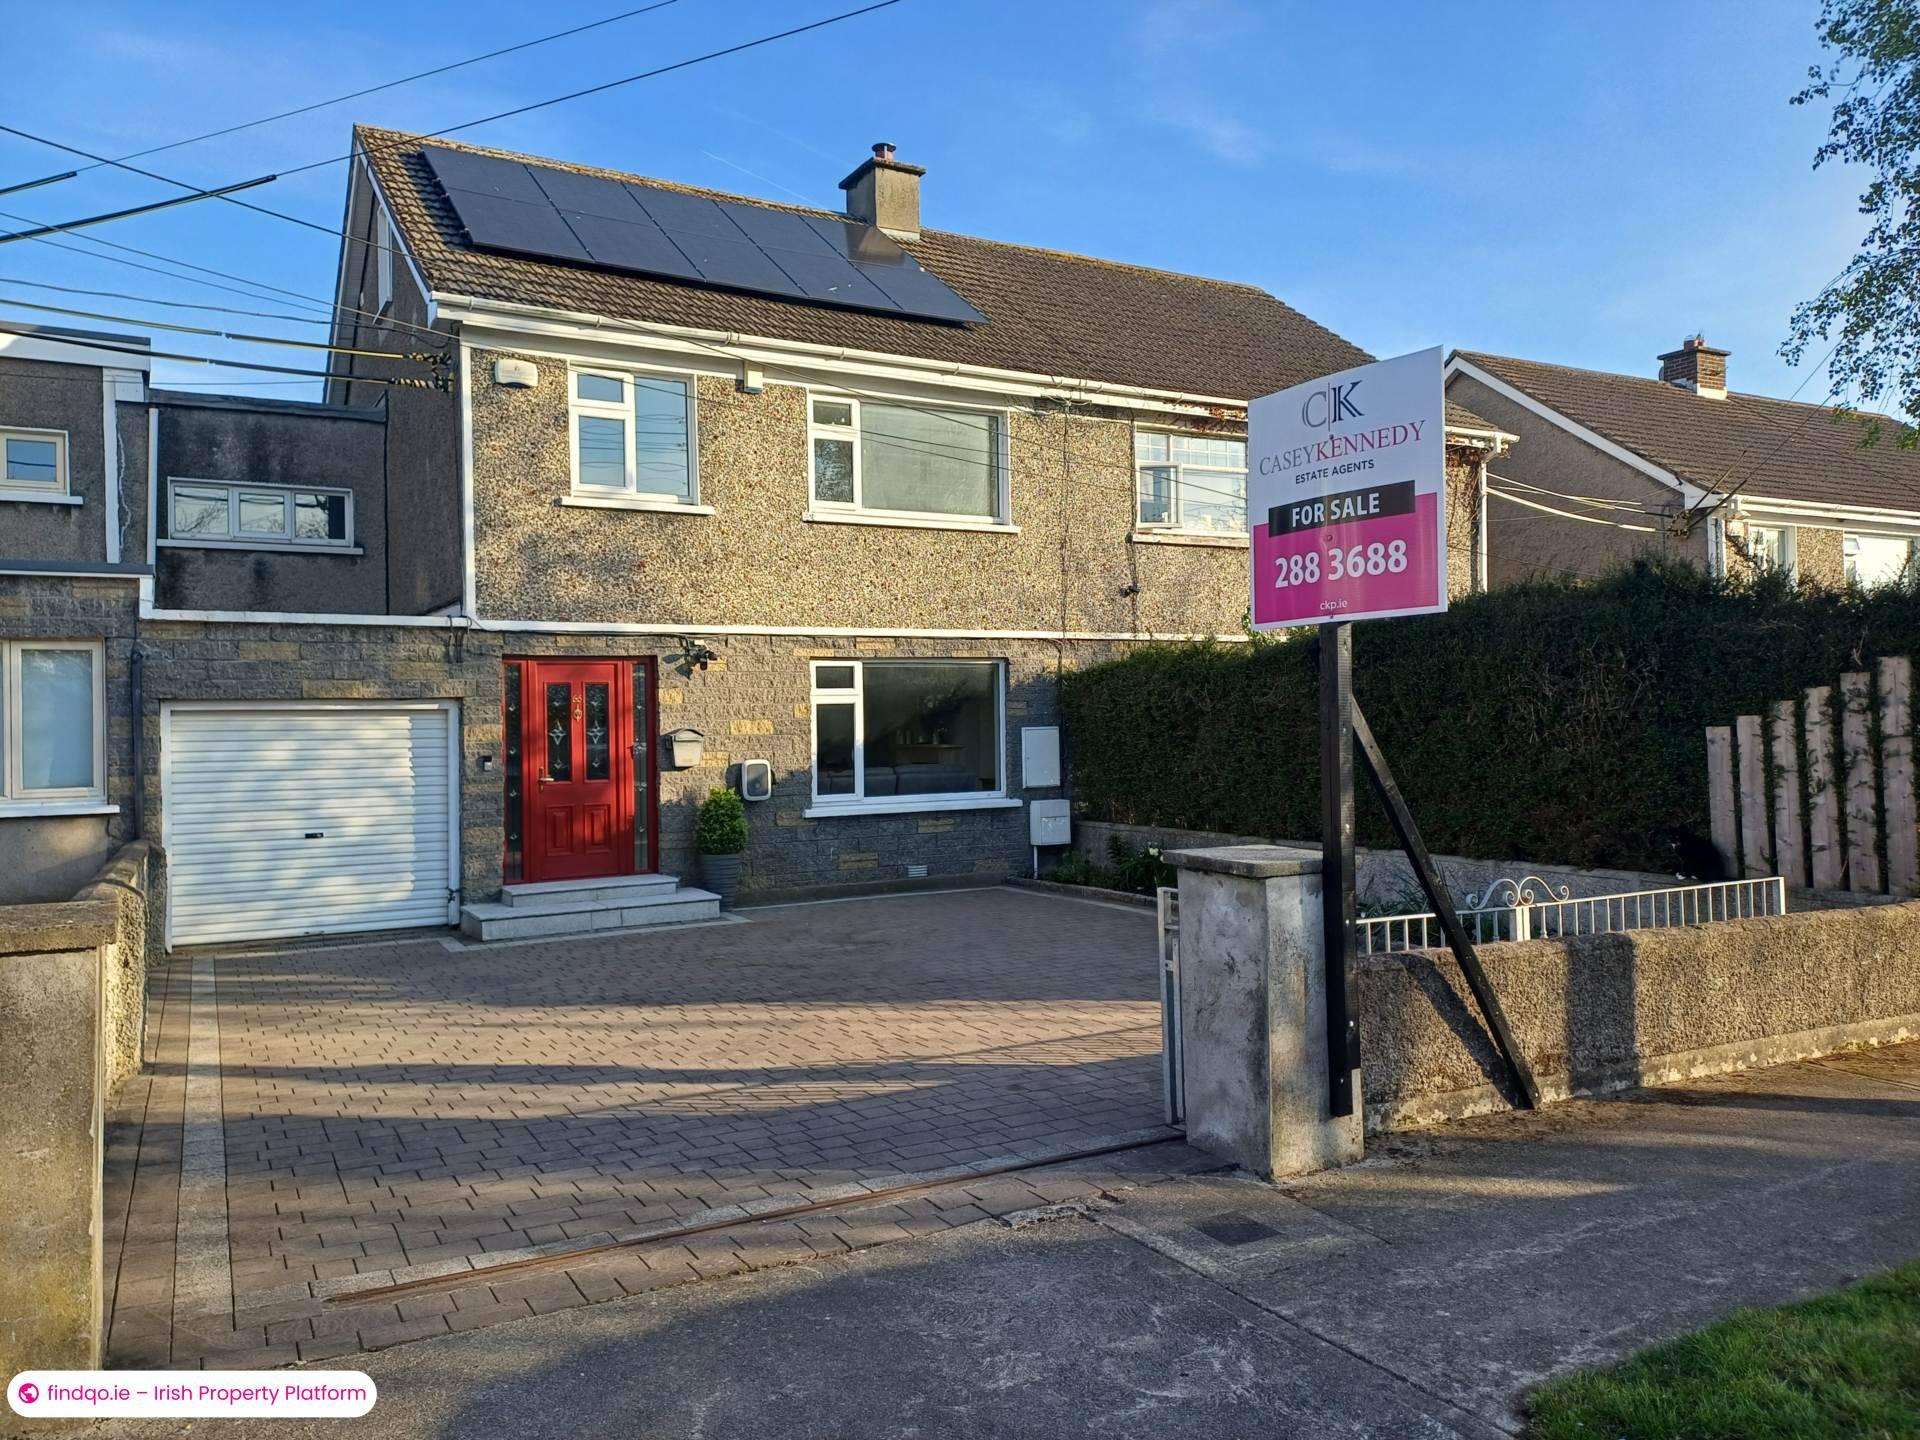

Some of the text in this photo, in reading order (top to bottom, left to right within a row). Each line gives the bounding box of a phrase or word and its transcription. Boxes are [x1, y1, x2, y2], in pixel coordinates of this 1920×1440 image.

[1295, 459, 1375, 484] ESTATE AGENTS
[1291, 492, 1380, 527] FOR SALE
[1275, 539, 1408, 588] 288 3688
[1320, 599, 1348, 611] ckp.ie
